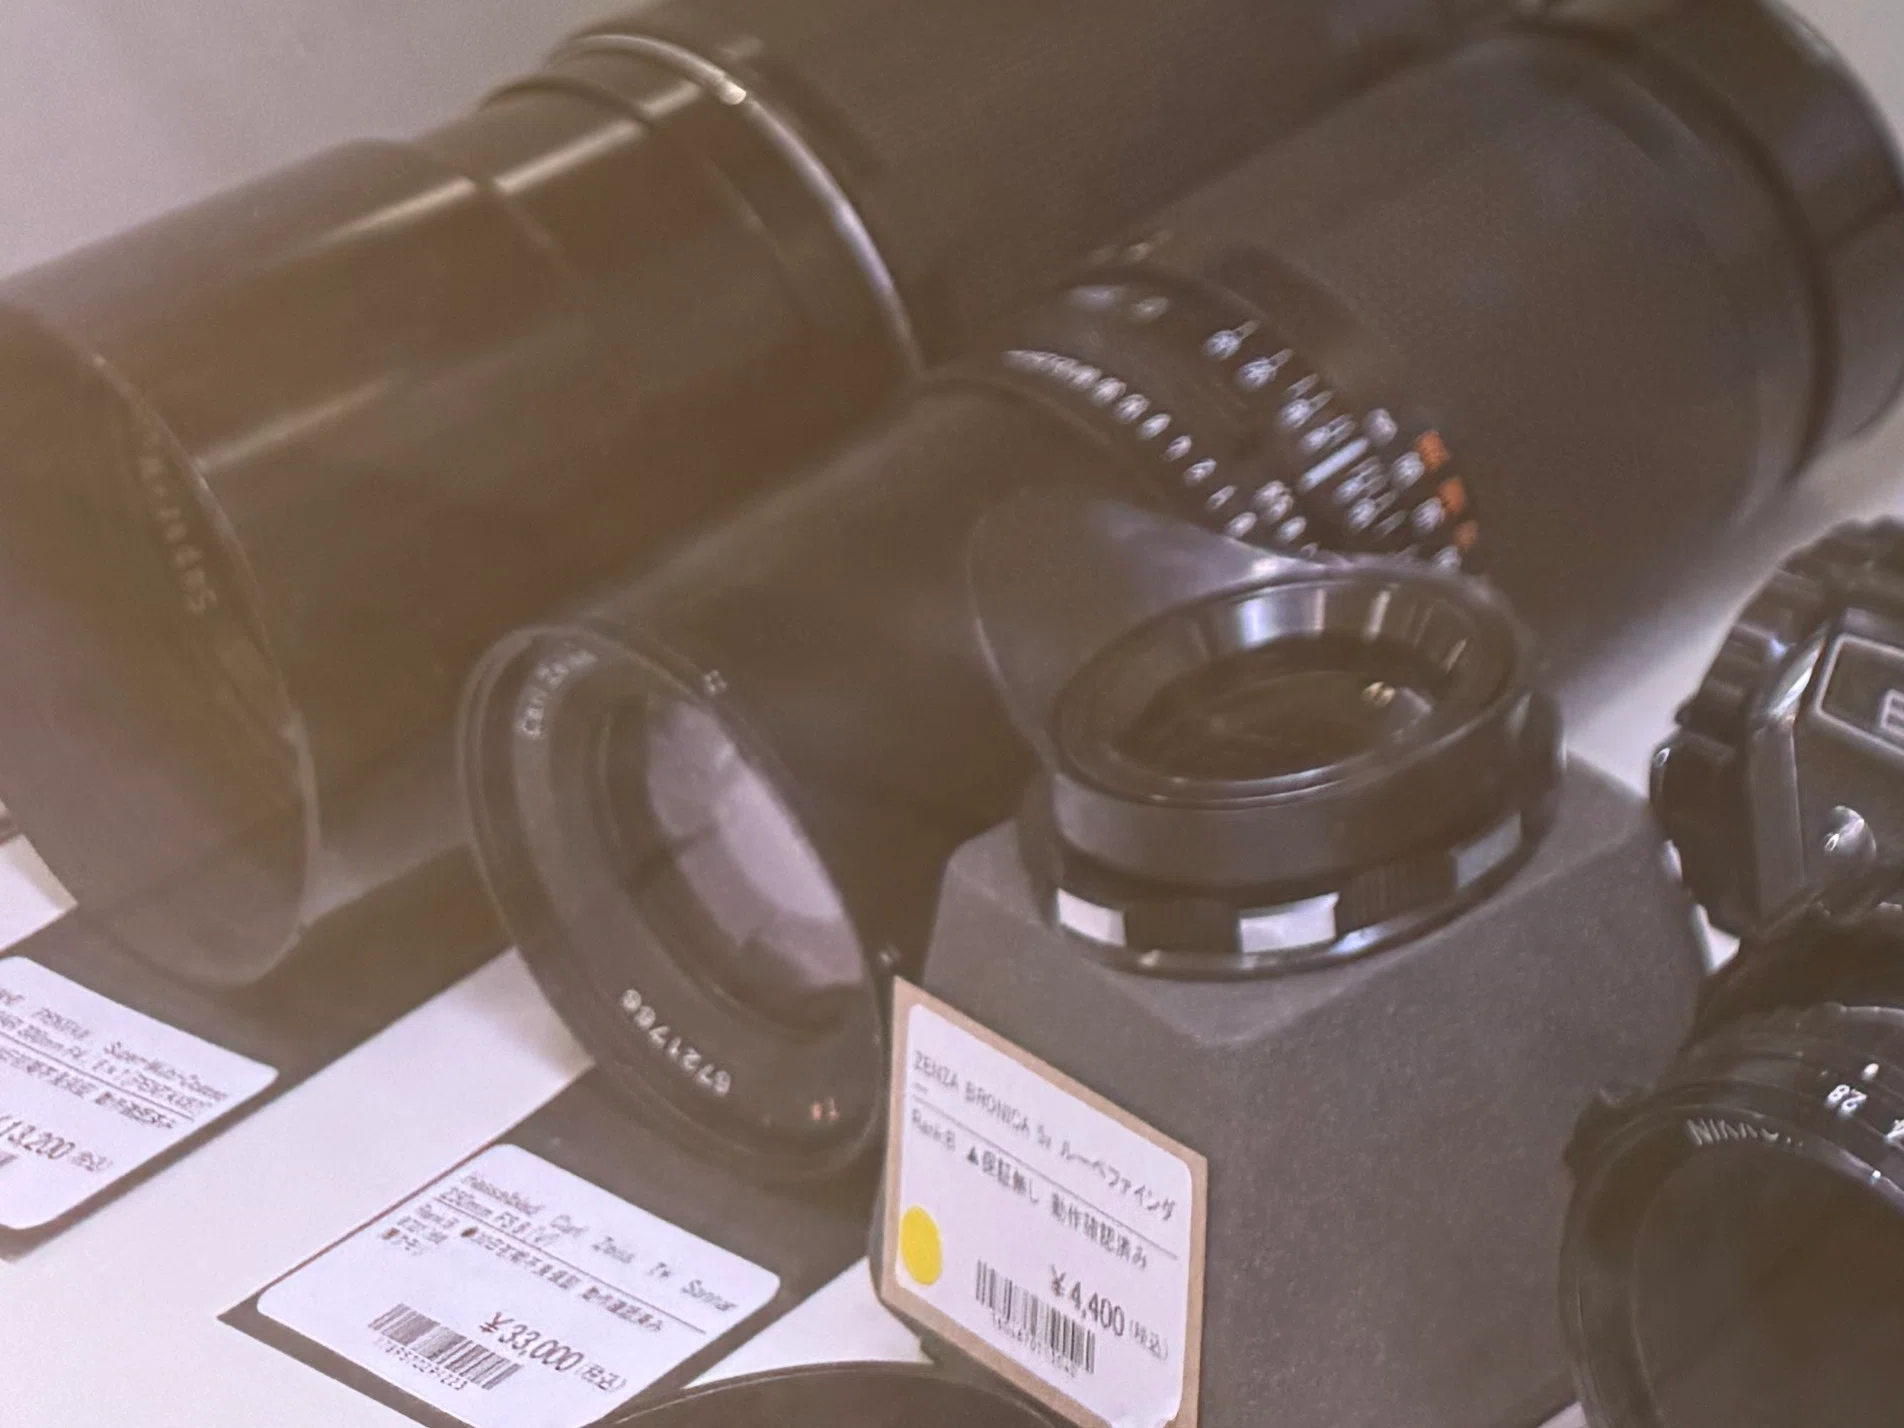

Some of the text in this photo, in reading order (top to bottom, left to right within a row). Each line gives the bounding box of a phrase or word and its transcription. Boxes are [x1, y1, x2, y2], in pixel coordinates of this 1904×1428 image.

[913, 1050, 959, 1094] ZENZA
[964, 1080, 1030, 1137] BRONICA
[1050, 1264, 1126, 1337] ¥4,400
[479, 1311, 584, 1371] ¥33,000
